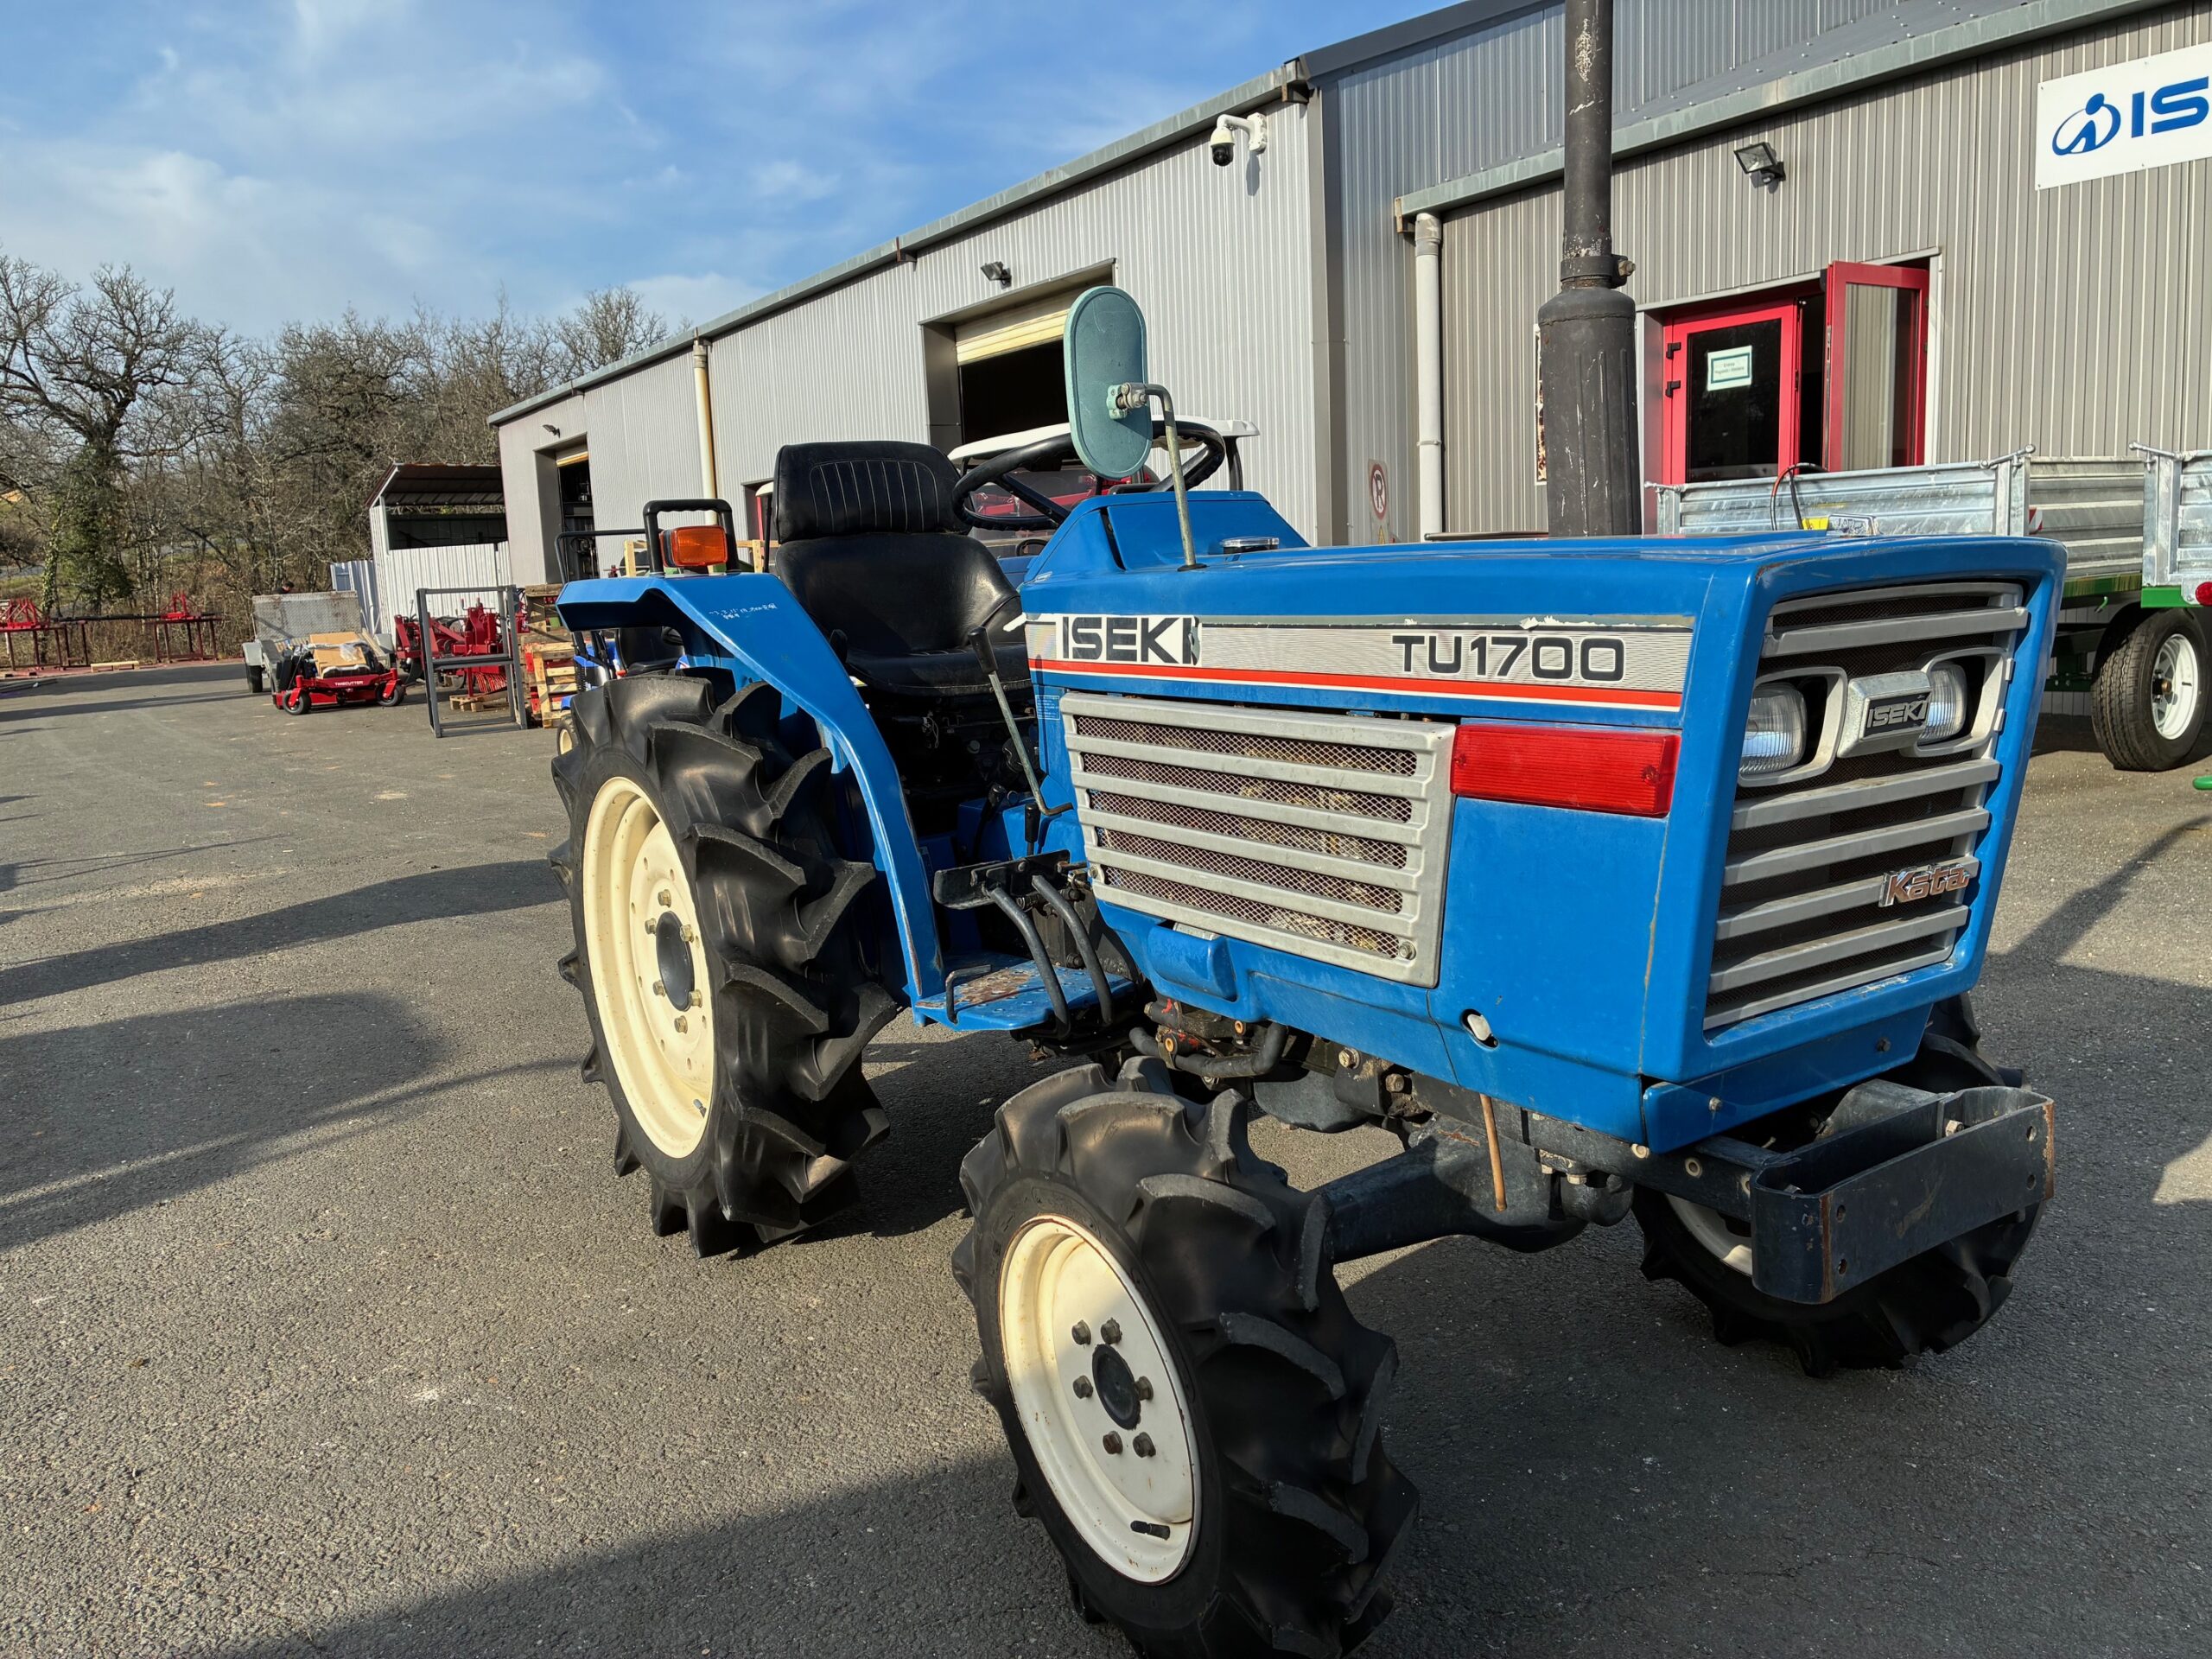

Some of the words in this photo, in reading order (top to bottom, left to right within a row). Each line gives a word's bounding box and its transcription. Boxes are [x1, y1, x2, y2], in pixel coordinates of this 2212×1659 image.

[1063, 616, 1198, 664] ISEKI
[1391, 635, 1624, 681] TU1700
[1866, 700, 1929, 728] ISEKI
